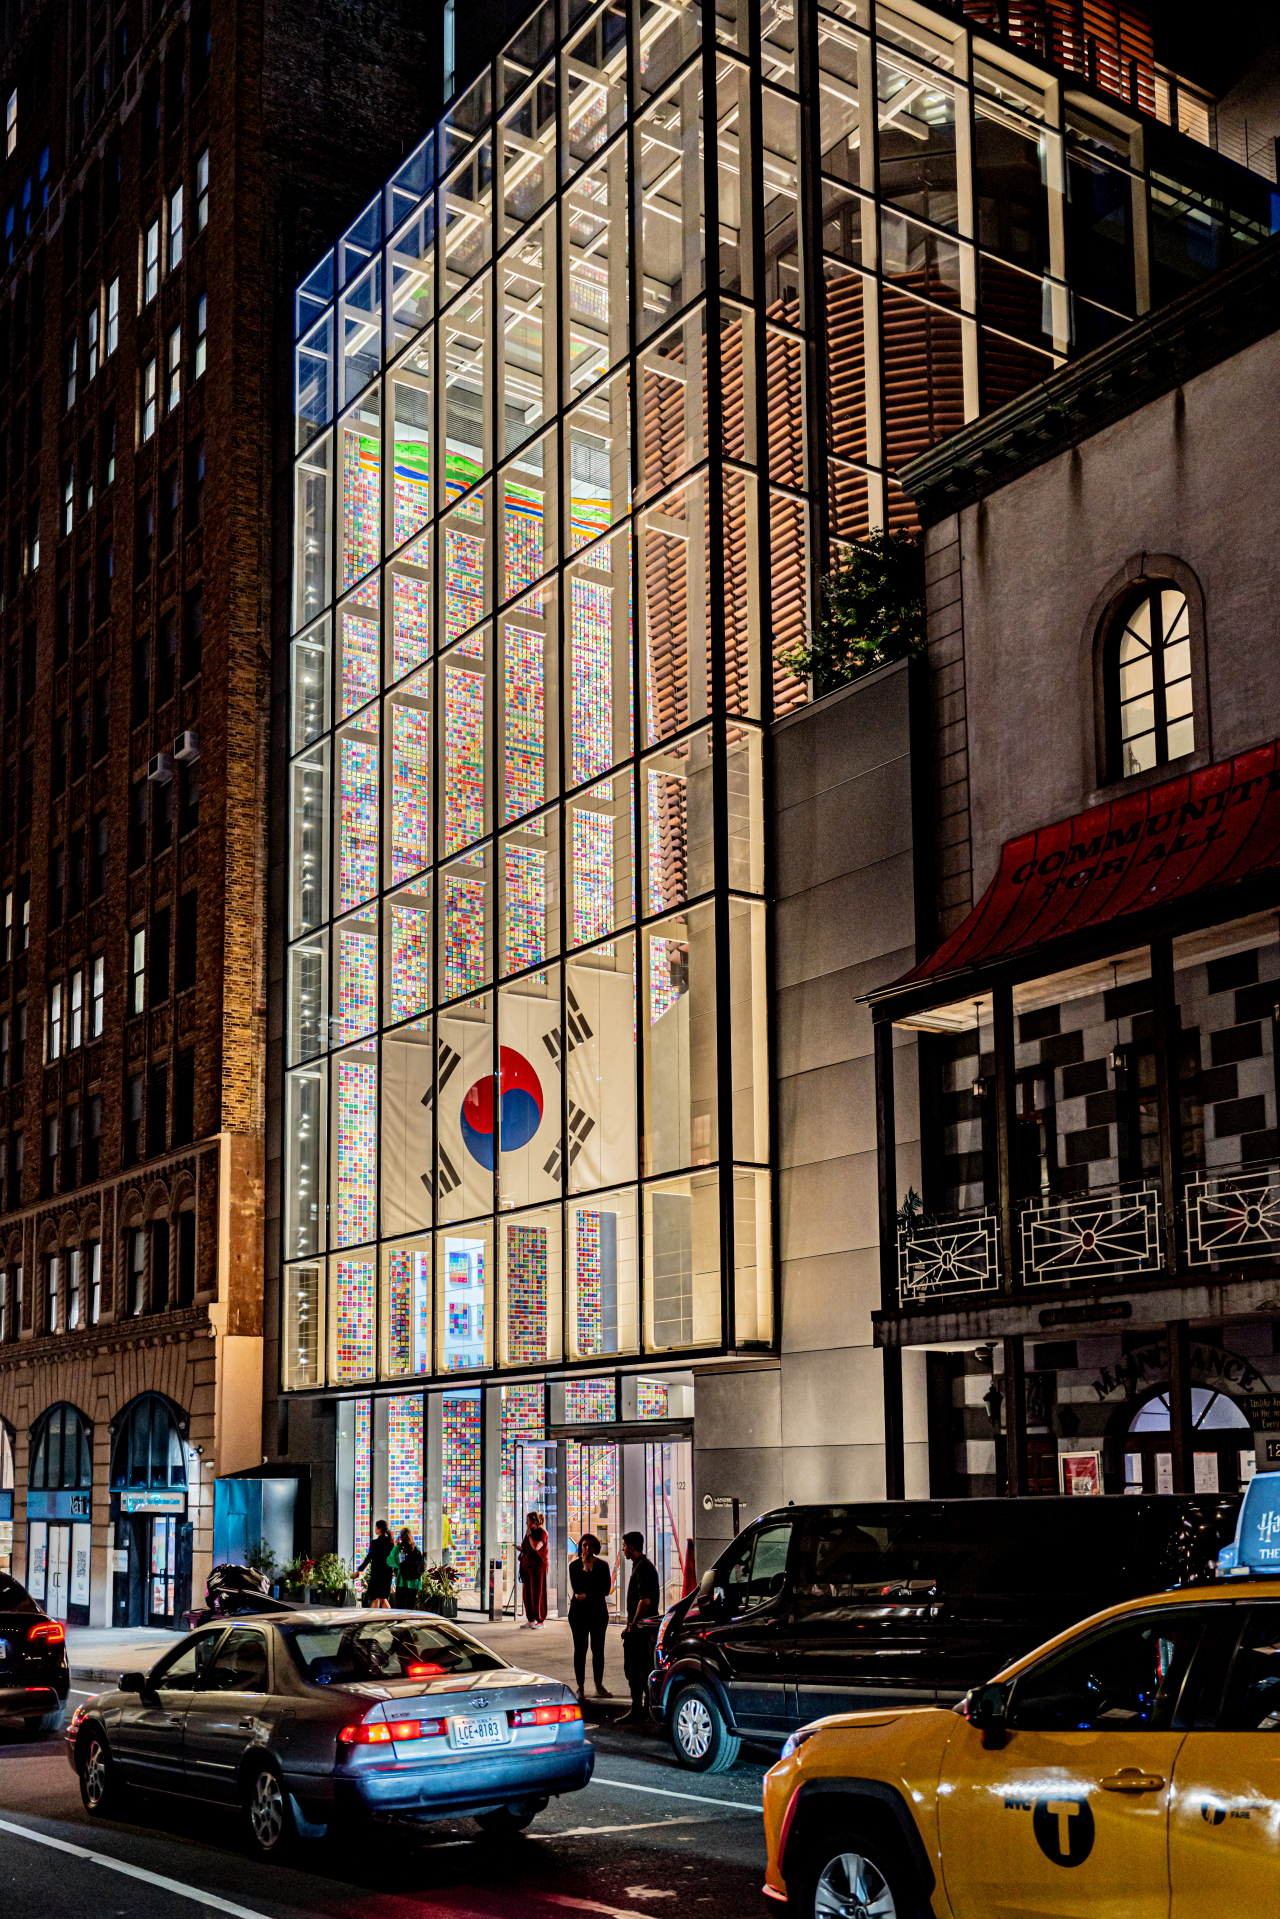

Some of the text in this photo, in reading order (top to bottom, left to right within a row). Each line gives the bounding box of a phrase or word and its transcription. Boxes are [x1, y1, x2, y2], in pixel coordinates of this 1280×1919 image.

[1037, 822, 1228, 901] FOR ALL
[1249, 1398, 1272, 1408] Unlike
[677, 1481, 686, 1490] 122
[1259, 1548, 1280, 1560] THE
[1003, 1797, 1032, 1812] NYC
[1230, 1811, 1251, 1820] FARE
